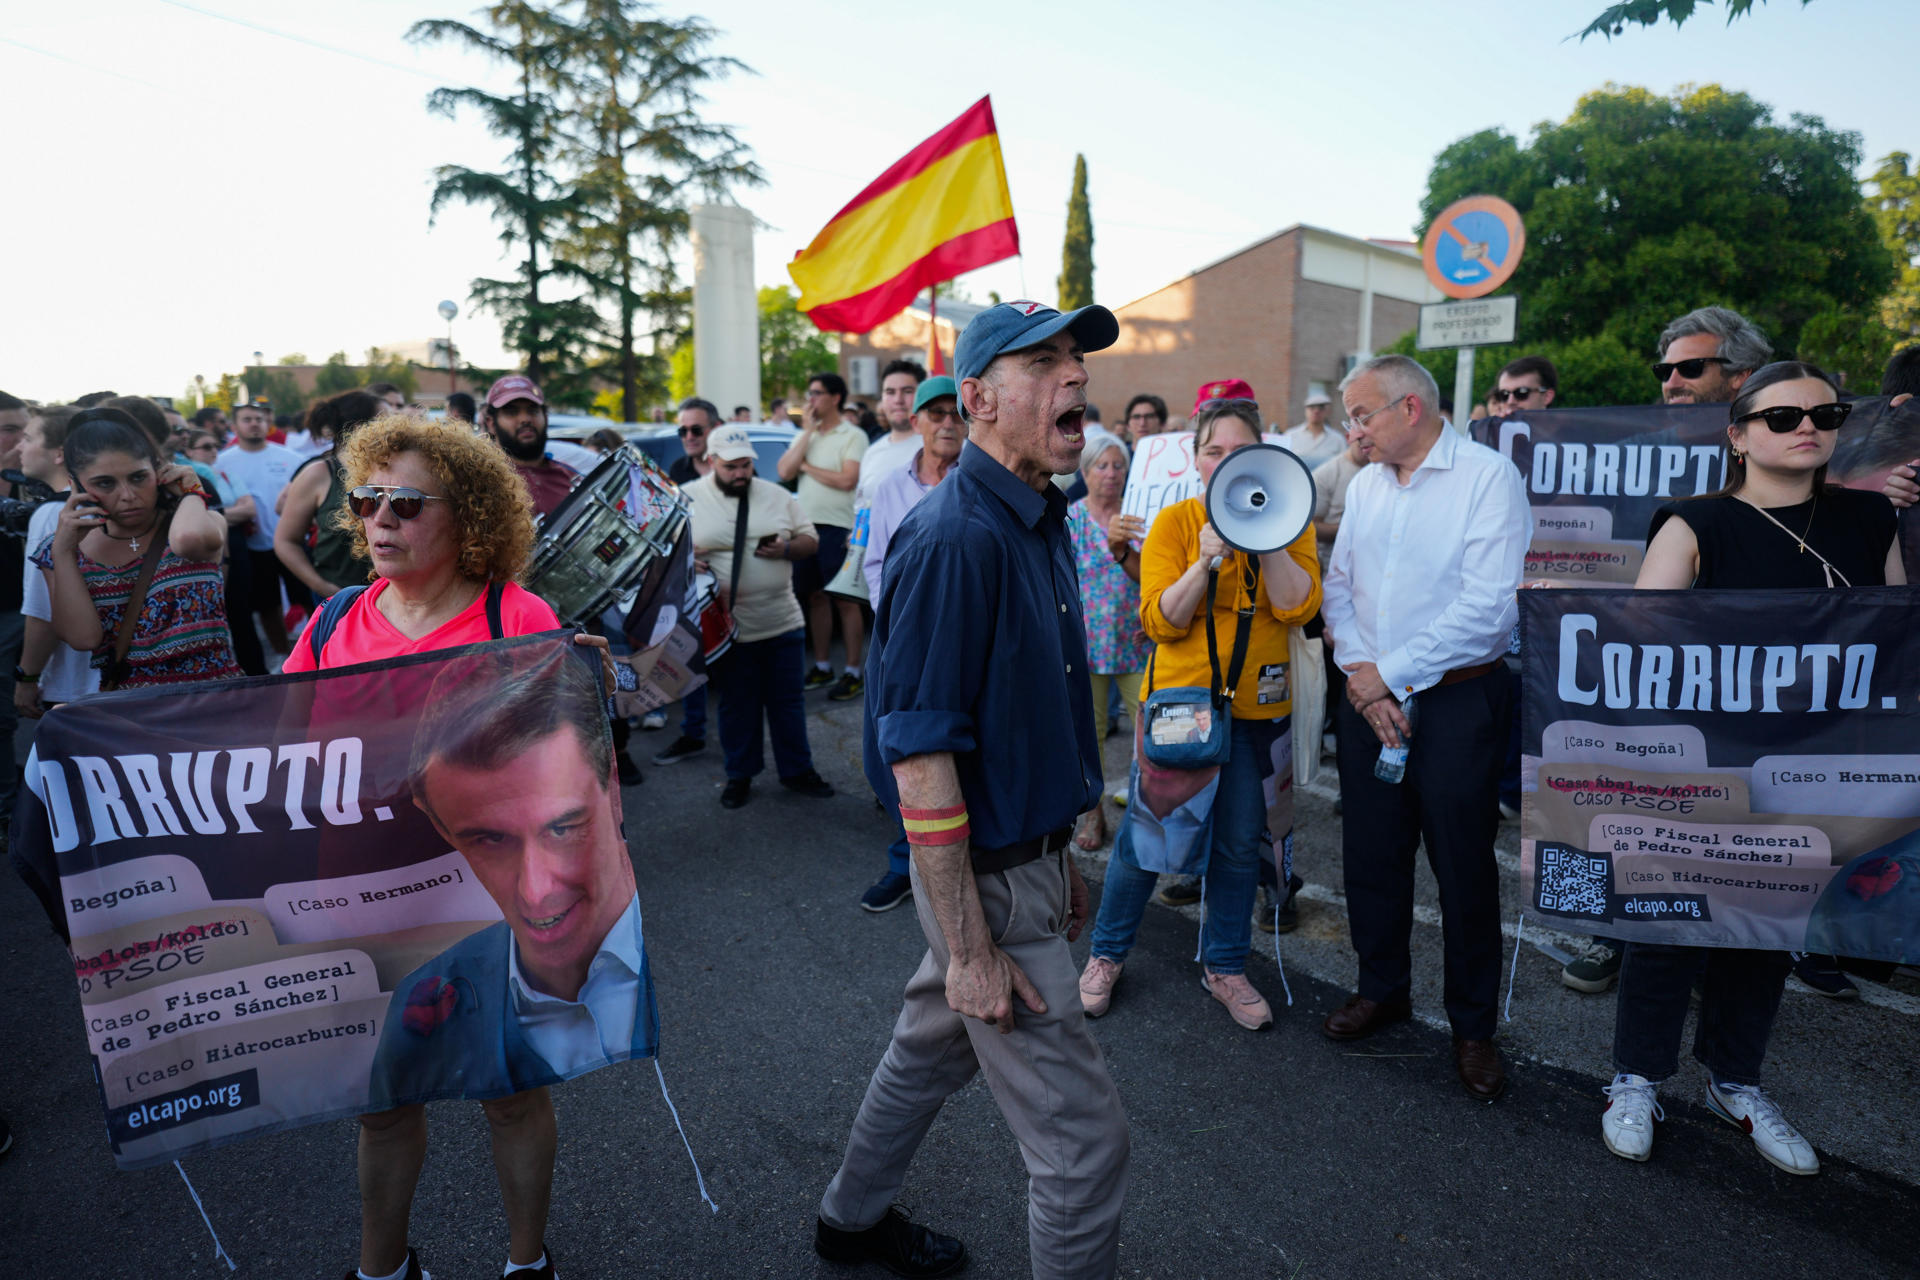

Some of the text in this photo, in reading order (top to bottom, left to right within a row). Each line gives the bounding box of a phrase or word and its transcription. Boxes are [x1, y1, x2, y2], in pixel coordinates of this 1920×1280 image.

[1142, 434, 1195, 481] PS
[1499, 420, 1728, 498] CORRUPT
[1539, 518, 1594, 531] Begoña]
[1543, 561, 1598, 574] PSOE
[1557, 613, 1897, 713] CORRUPTO.
[1564, 736, 1684, 757] [Caso Begoña]
[25, 737, 395, 853] ORRUPTO.
[1771, 771, 1827, 786] [Caso
[1573, 791, 1695, 815] Caso PSOE
[1602, 824, 1812, 848] [Caso Fiscal General
[1613, 839, 1793, 866] de Pedro Sánchez]
[70, 876, 177, 913] Begoña]
[288, 869, 464, 916] [Caso Hermano]
[1625, 871, 1819, 894] [Caso Hidrocarburos]
[1625, 897, 1701, 918] elcapo.org
[74, 920, 249, 971] balos/Koldo]
[100, 945, 205, 989] PSOE
[165, 980, 250, 1012] Fiscal
[264, 961, 356, 990] General
[101, 985, 339, 1053] de Pedro Sánchez]
[125, 1019, 376, 1093] [Caso Hidrocarburos]
[128, 1082, 242, 1128] elcapo.org
